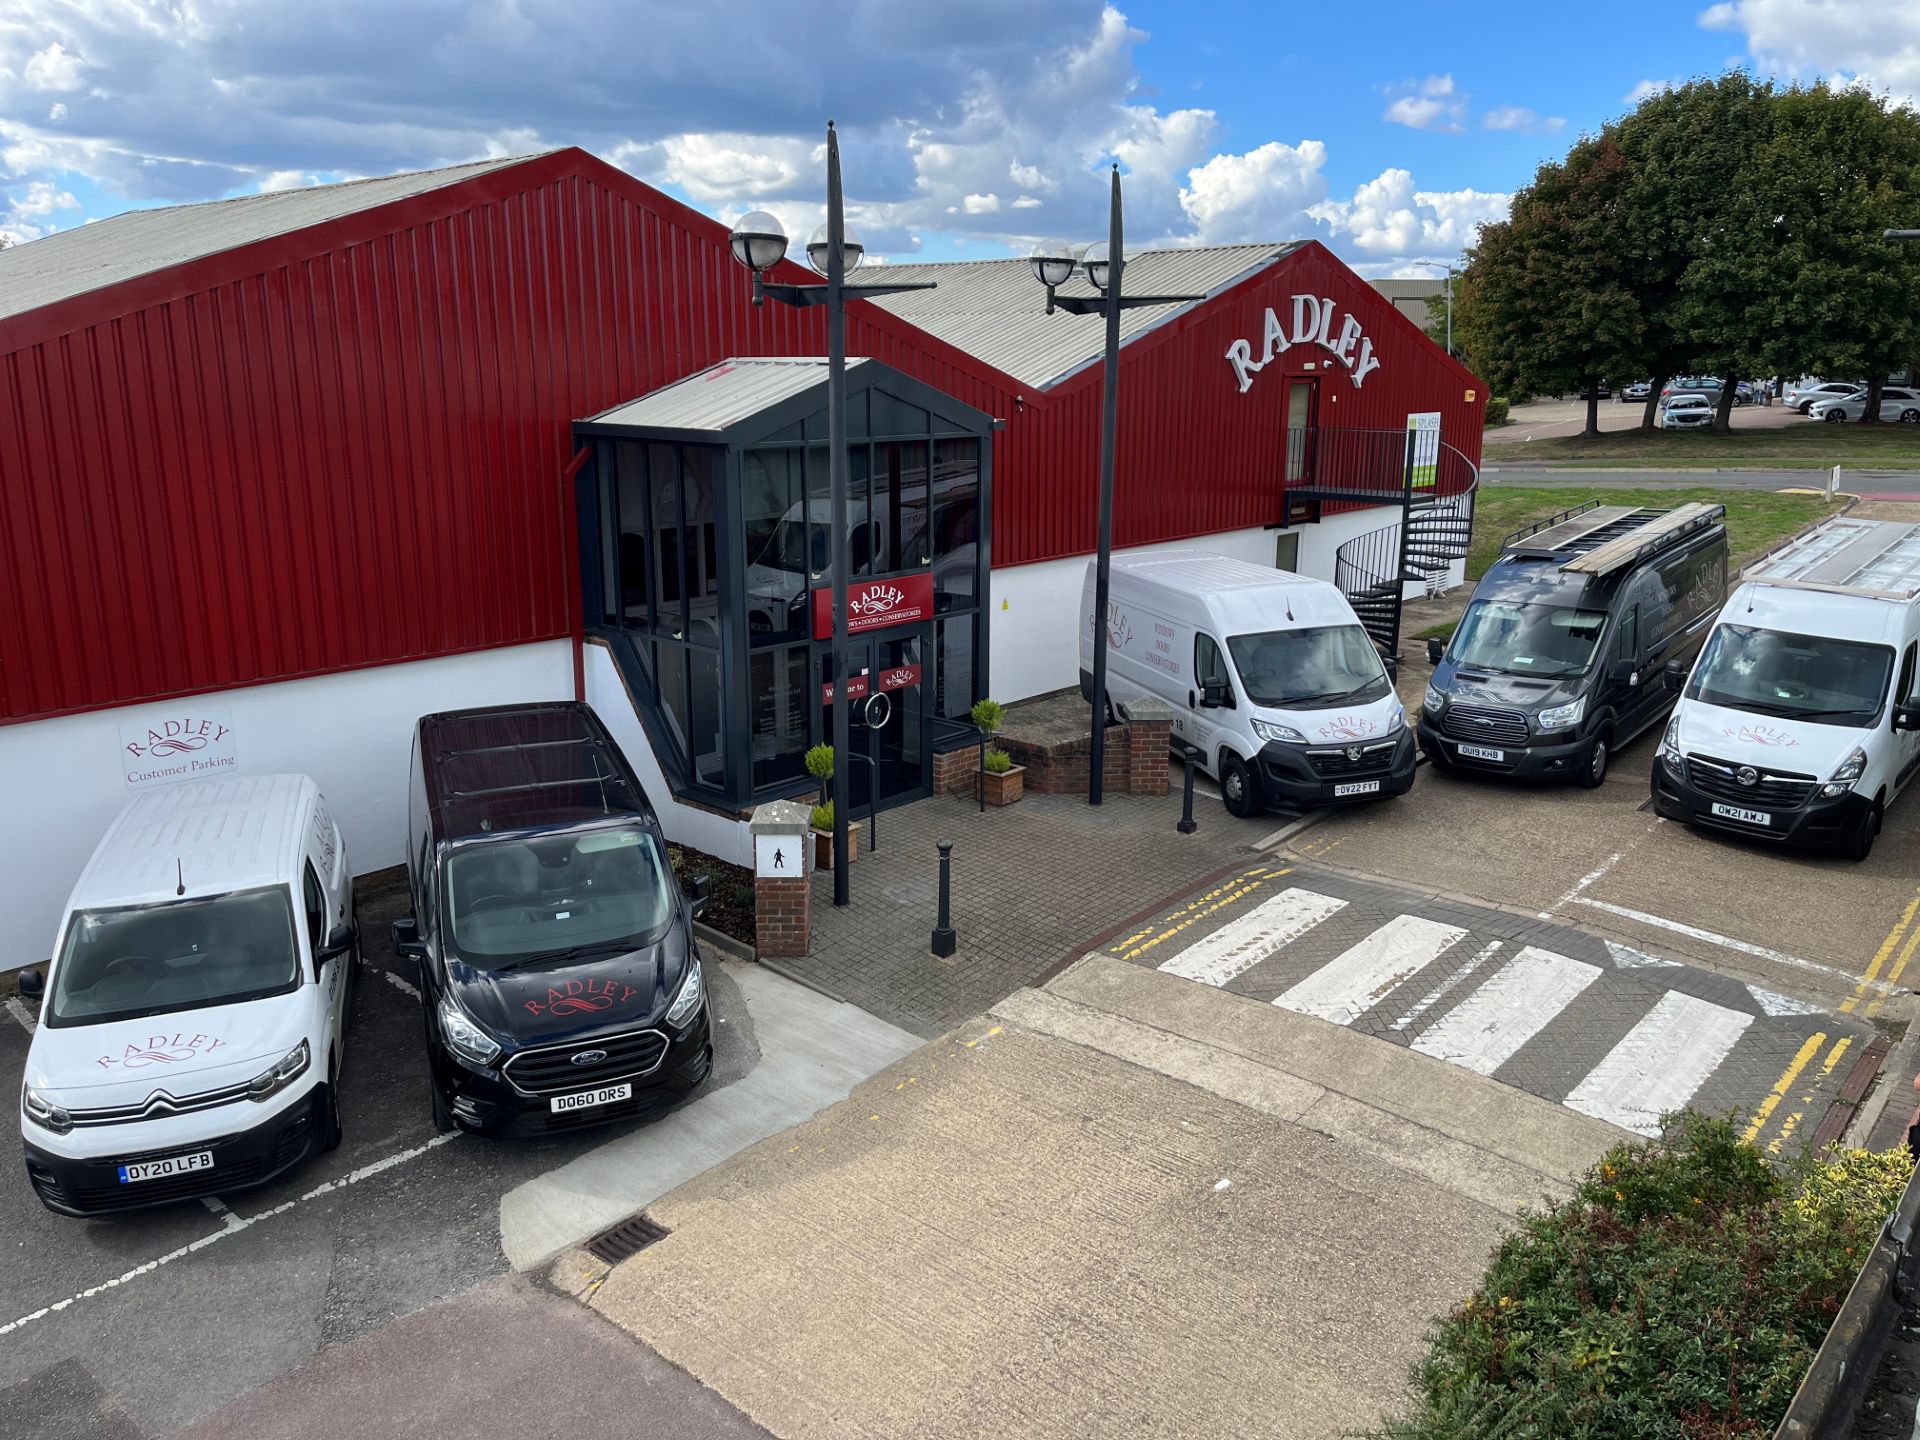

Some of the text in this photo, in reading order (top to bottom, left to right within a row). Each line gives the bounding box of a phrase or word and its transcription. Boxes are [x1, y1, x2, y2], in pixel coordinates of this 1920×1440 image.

[1225, 294, 1380, 393] RADLEY
[850, 585, 904, 614] RADLEY
[862, 618, 879, 626] DOORS
[857, 683, 864, 692] to
[885, 669, 914, 686] RADLEY
[126, 718, 229, 757] RADLEY
[1319, 717, 1377, 738] RADLEY
[1723, 725, 1799, 747] RADLEY
[1462, 746, 1499, 759] OU19 KHB
[127, 757, 236, 783] Customer Parking
[1340, 784, 1361, 794] OV22
[524, 979, 637, 1016] RADLEY
[96, 1034, 226, 1069] RADLEY
[598, 1086, 626, 1102] ORS
[129, 1154, 210, 1179] OY20 LFB
